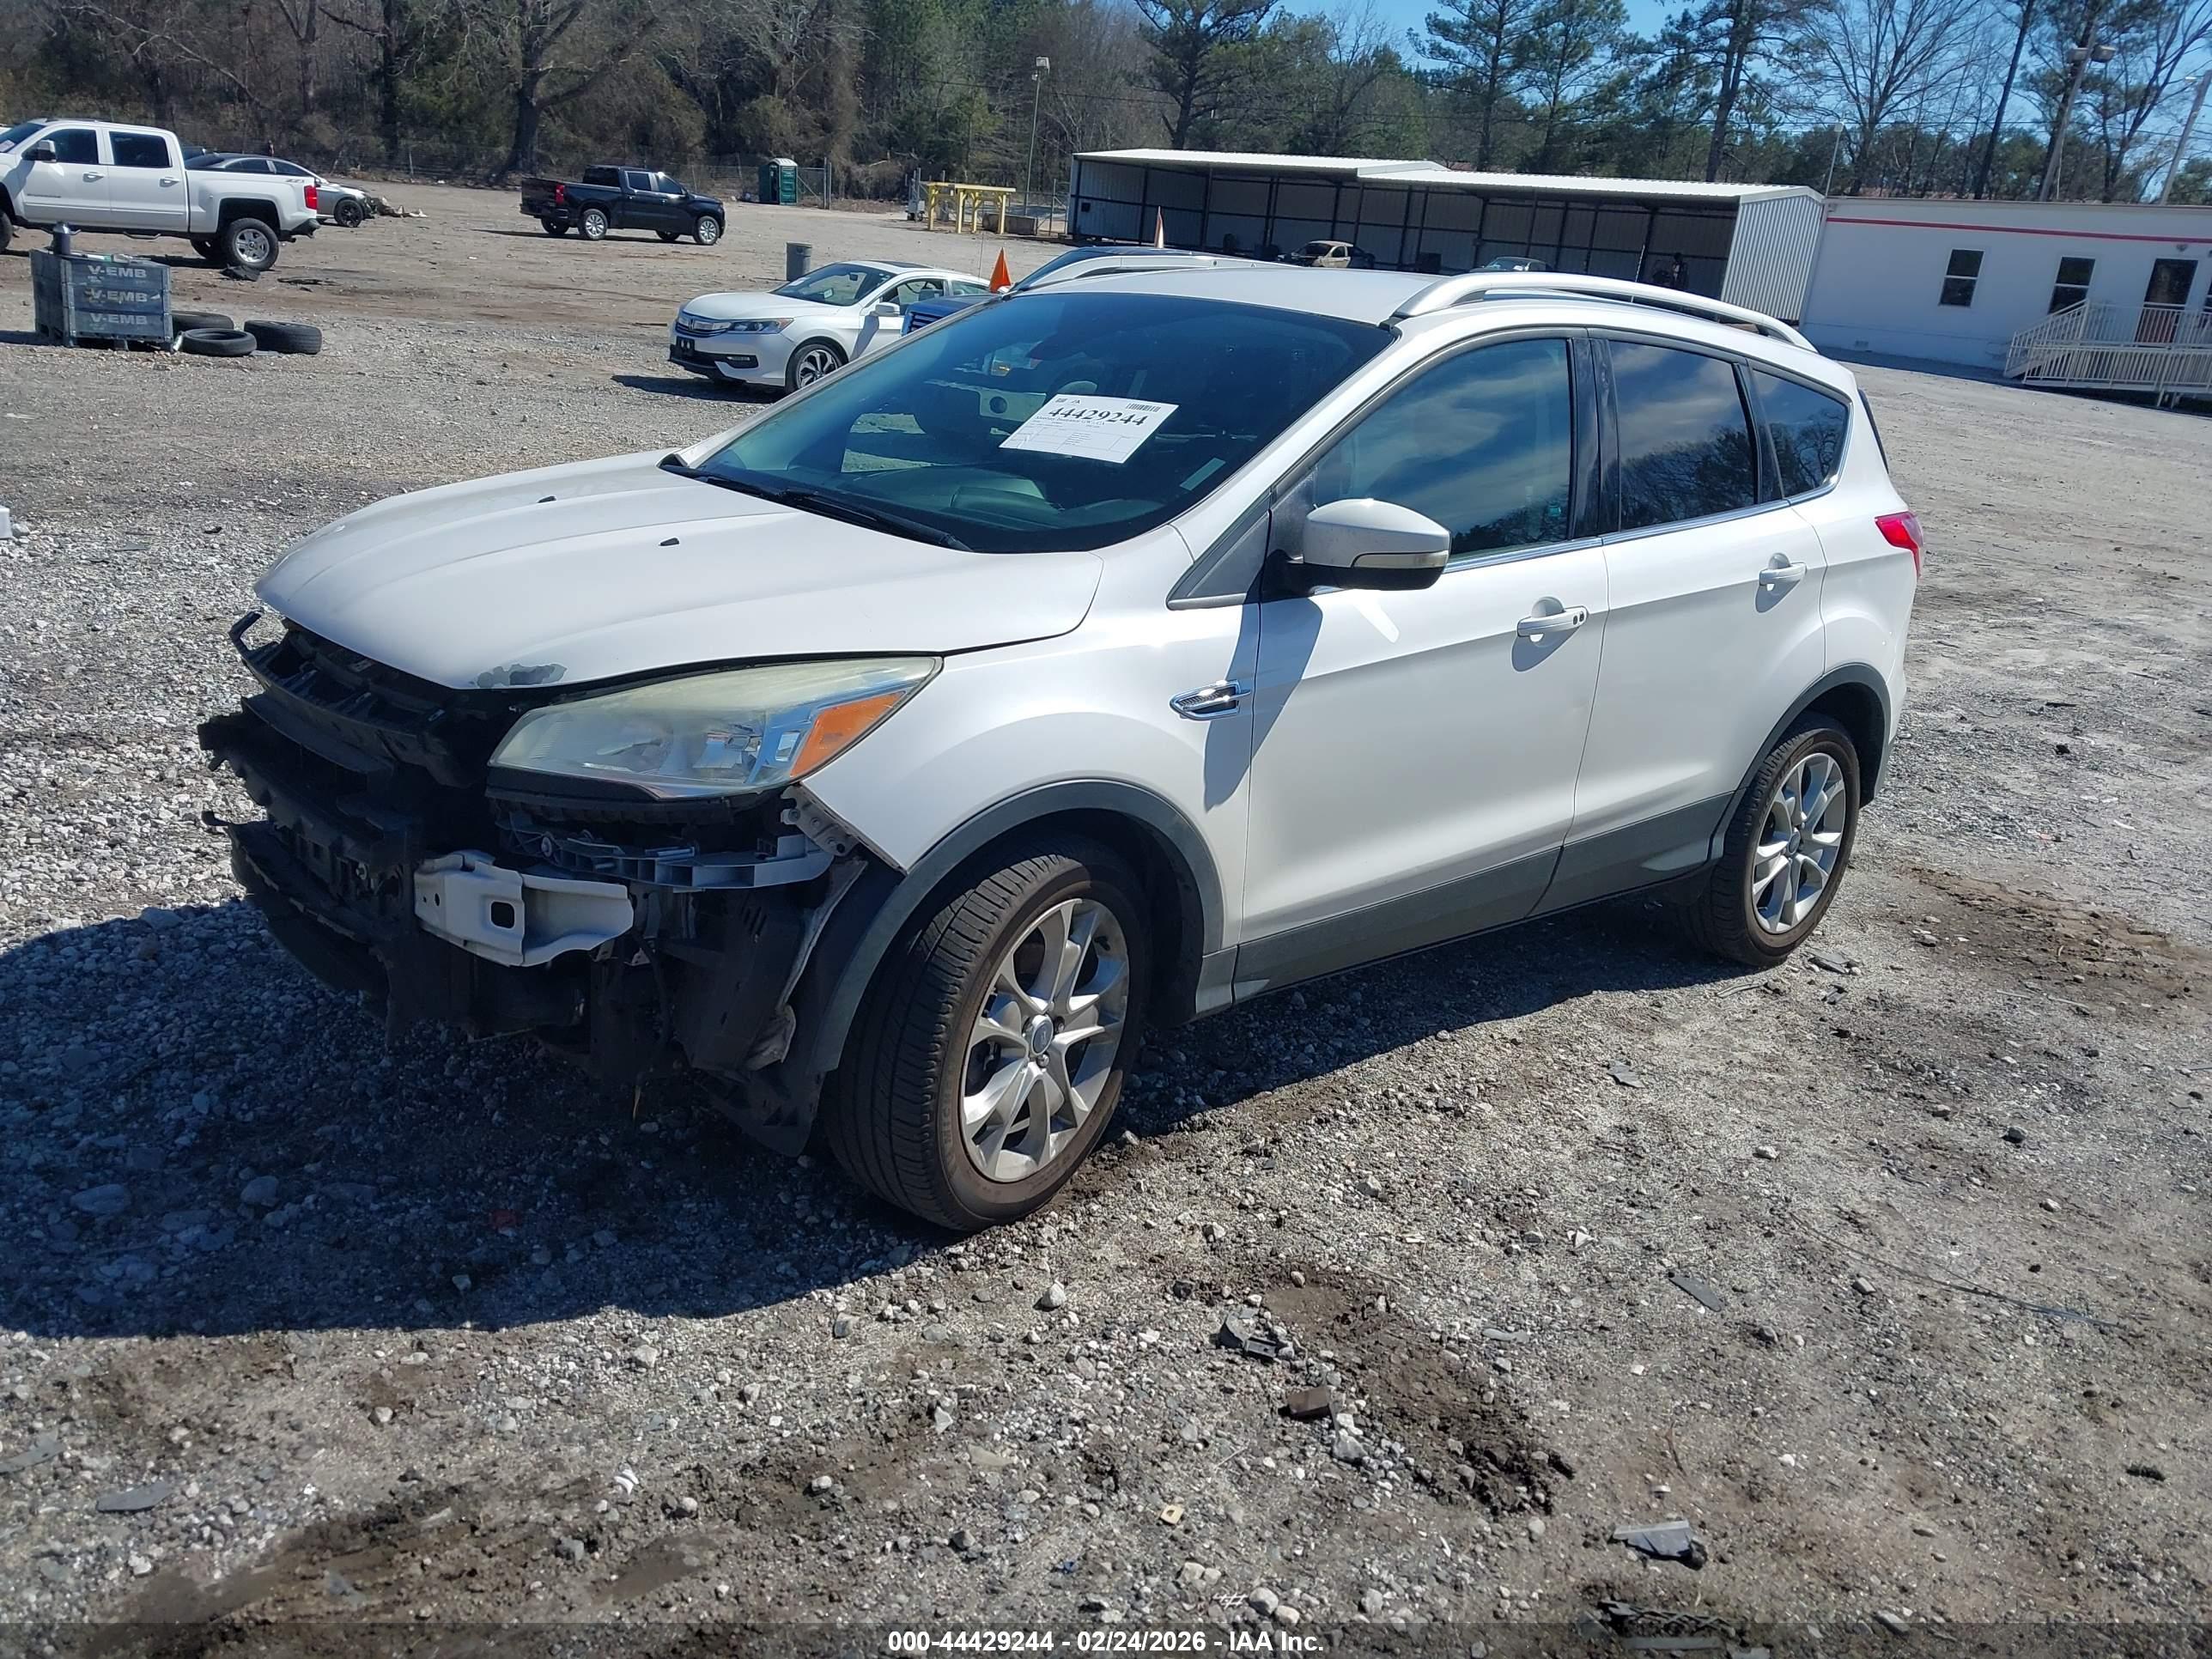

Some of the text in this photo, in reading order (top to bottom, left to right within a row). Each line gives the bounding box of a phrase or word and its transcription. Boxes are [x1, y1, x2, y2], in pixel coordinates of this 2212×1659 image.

[88, 264, 147, 278] V-EMB
[89, 289, 148, 302] V-EMB
[89, 313, 148, 325] V-EMB
[1048, 407, 1148, 426] 44429244
